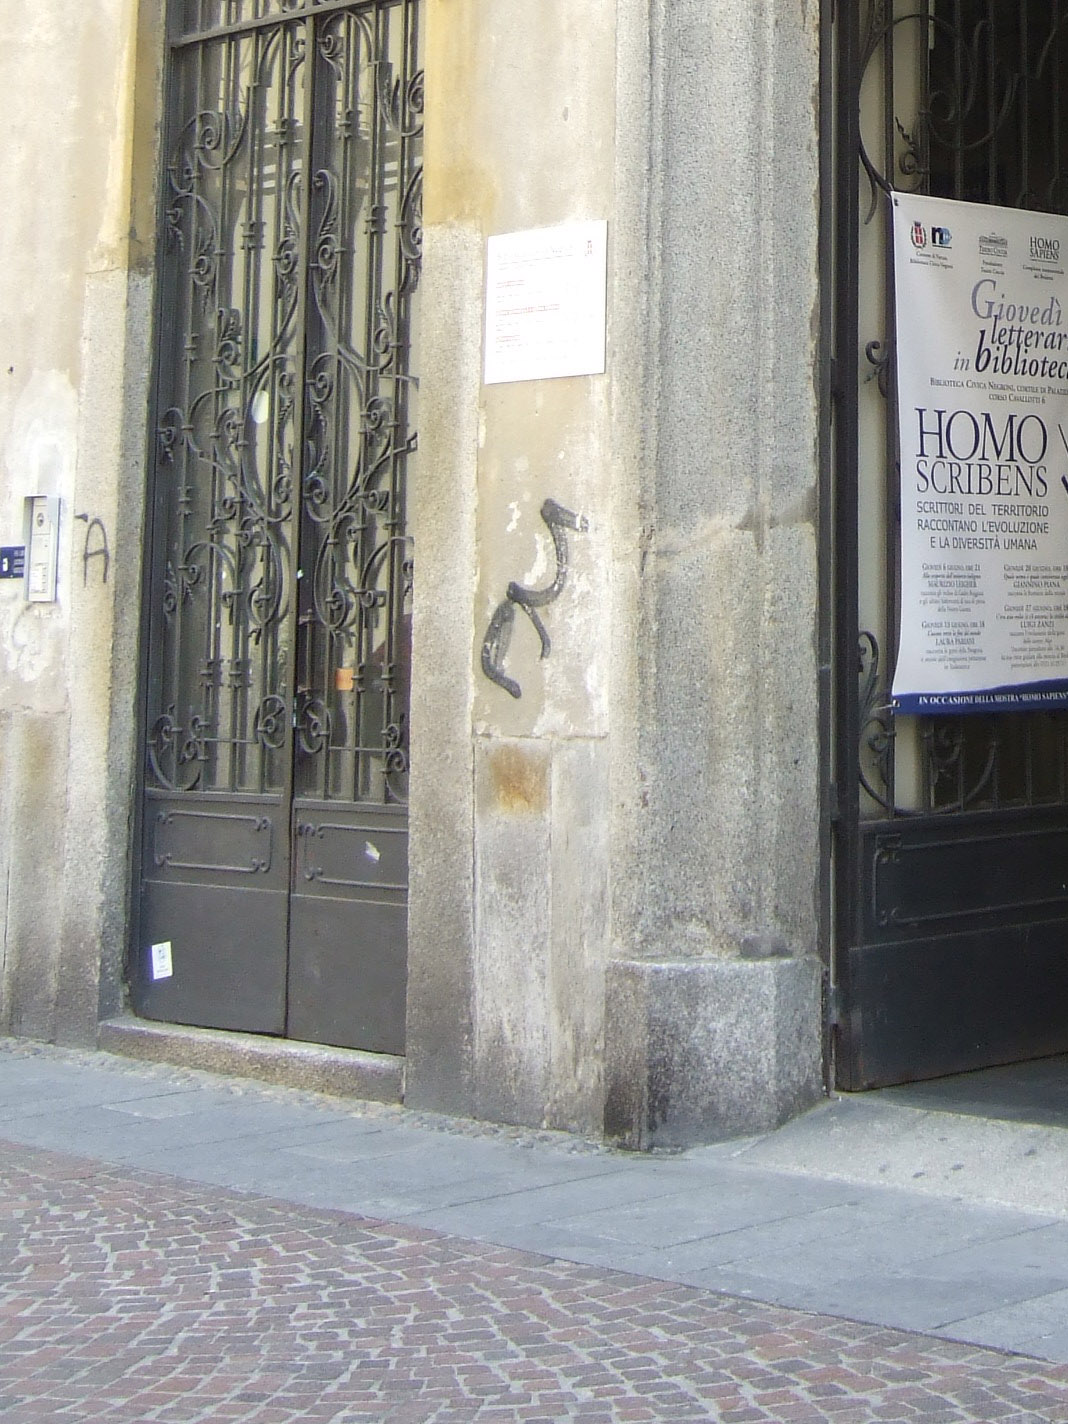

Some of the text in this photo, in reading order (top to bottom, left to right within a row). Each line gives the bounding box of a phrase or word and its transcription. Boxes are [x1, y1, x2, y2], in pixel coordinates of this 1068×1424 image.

[1029, 236, 1060, 251] HOMO
[1029, 248, 1060, 261] SAPIENS
[971, 278, 1064, 327] Giovedì
[953, 350, 970, 372] in
[914, 407, 1048, 464] HOMO
[916, 459, 1049, 498] SCRIBENS
[916, 500, 1049, 517] SCRITTORI DEL TERRITORIO
[917, 518, 1050, 534] RACCONTANO L'EVOLUZIONE
[930, 534, 1038, 551] E LA DIVERSITÀ UMANA
[919, 695, 928, 705] IN
[929, 695, 974, 705] OCCASIONE
[975, 694, 994, 703] DELLA
[994, 694, 1019, 703] MOSTRA
